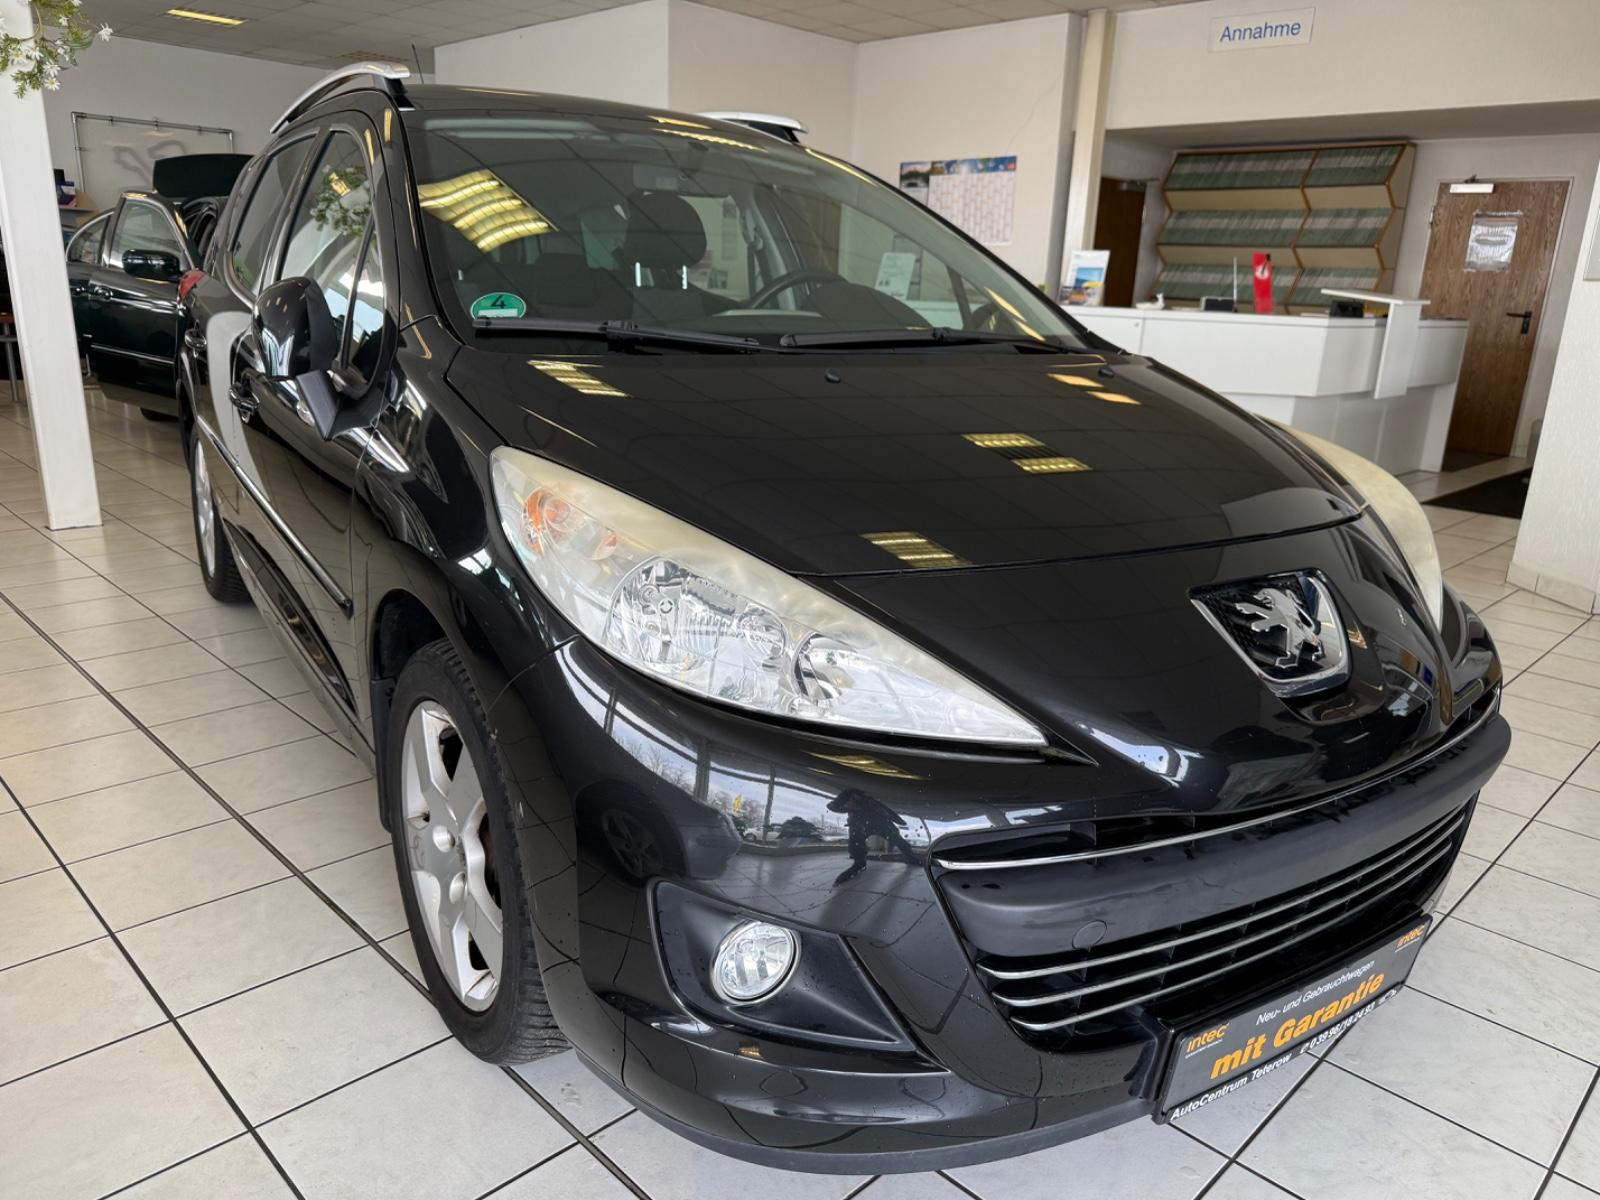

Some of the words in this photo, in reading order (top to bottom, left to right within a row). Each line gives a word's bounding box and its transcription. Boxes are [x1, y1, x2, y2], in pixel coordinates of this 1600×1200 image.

[1219, 21, 1301, 42] Annahme
[491, 294, 507, 309] 4
[1256, 1008, 1282, 1026] Neu-
[1282, 994, 1303, 1014] und
[1302, 960, 1375, 1003] Gebrauchtwagen
[1210, 1033, 1267, 1080] mit
[1273, 973, 1385, 1048] Garantie
[1170, 1077, 1248, 1121] AutoCentrum
[1251, 1053, 1292, 1081] Teterow
